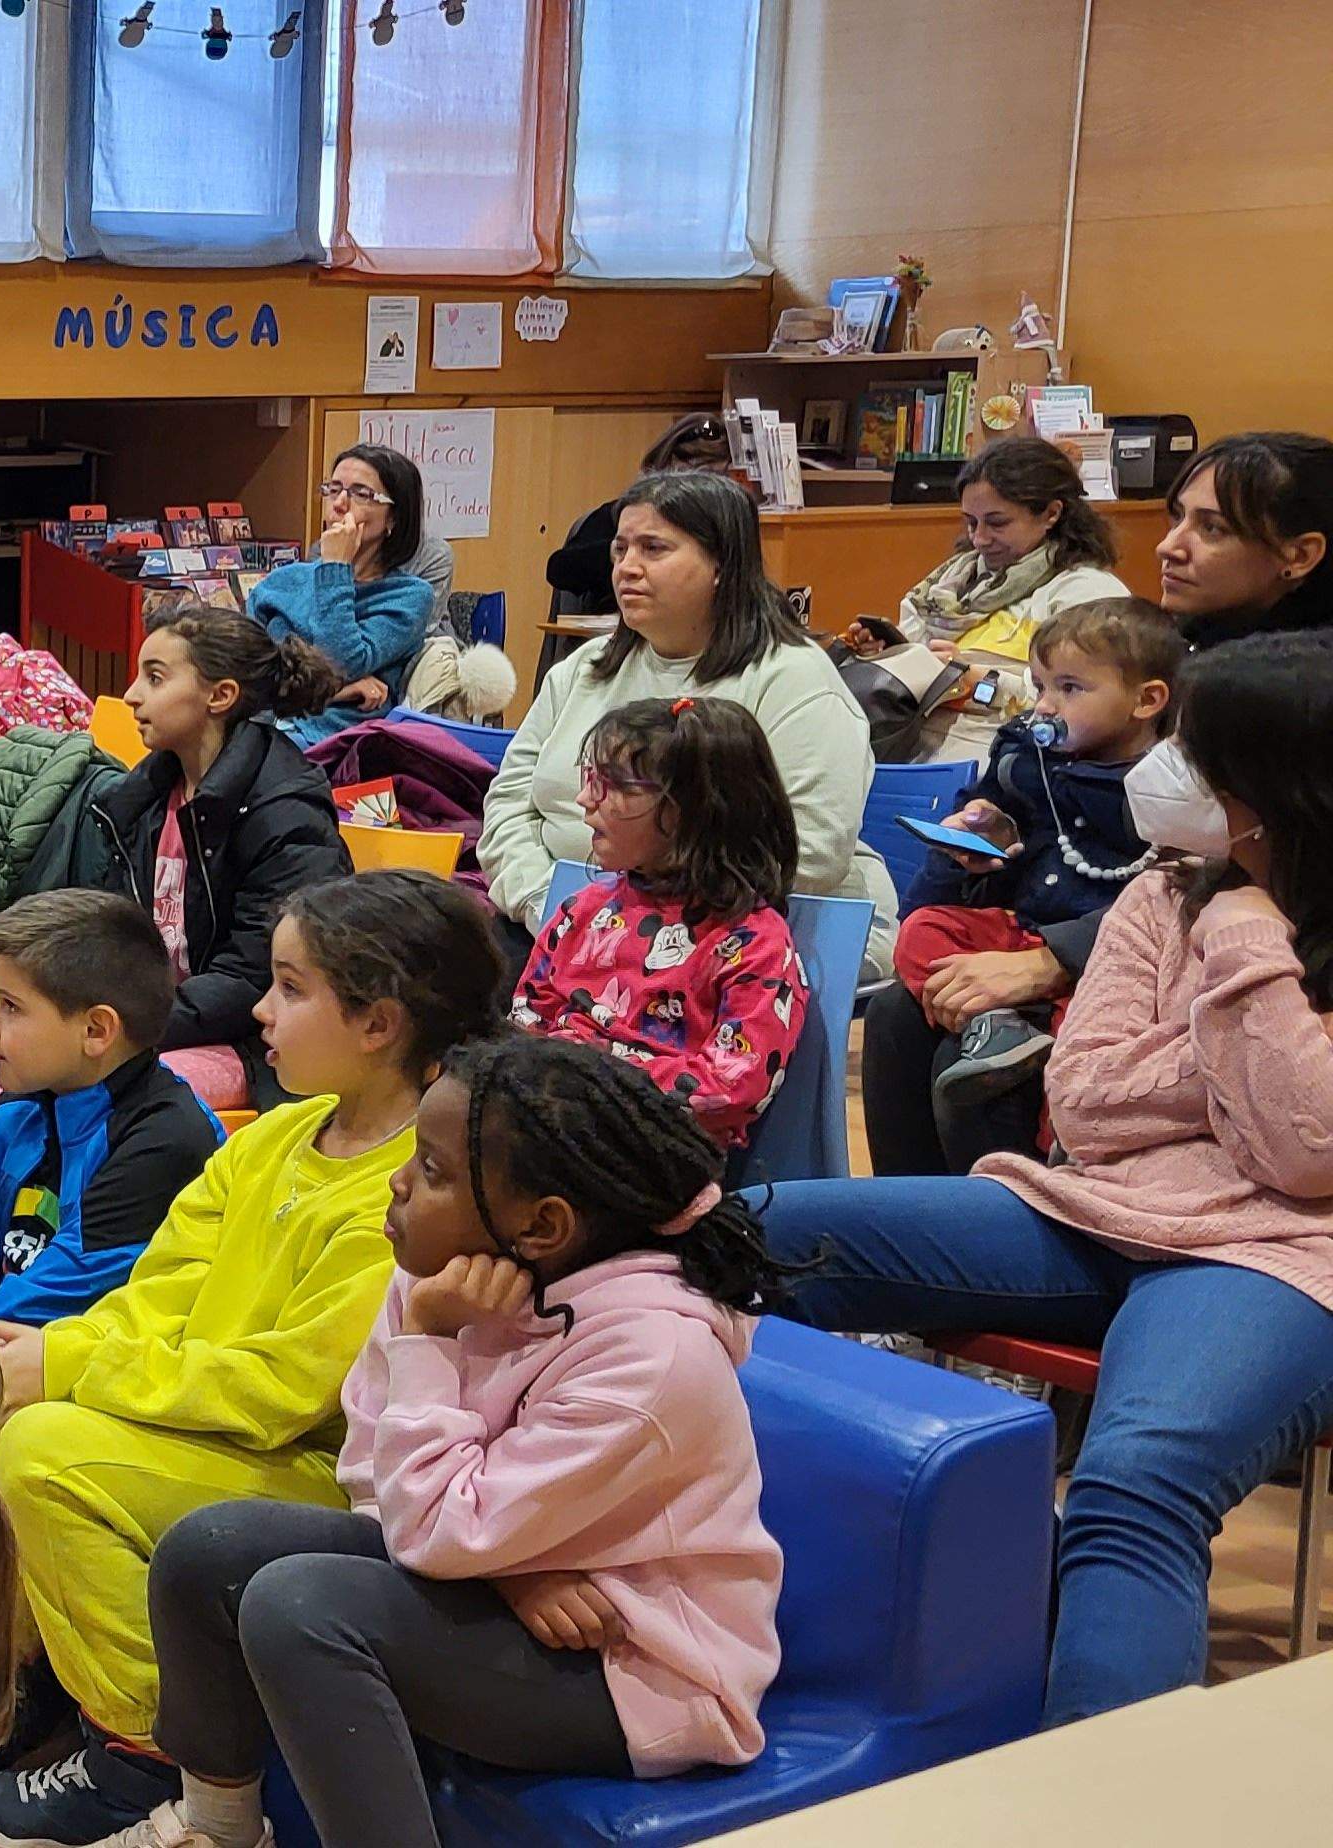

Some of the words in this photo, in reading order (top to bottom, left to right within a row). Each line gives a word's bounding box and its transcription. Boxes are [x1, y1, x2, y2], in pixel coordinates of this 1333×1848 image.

[54, 293, 280, 349] MÚSICA
[84, 509, 92, 519] P
[141, 538, 149, 548] U
[571, 928, 629, 968] M
